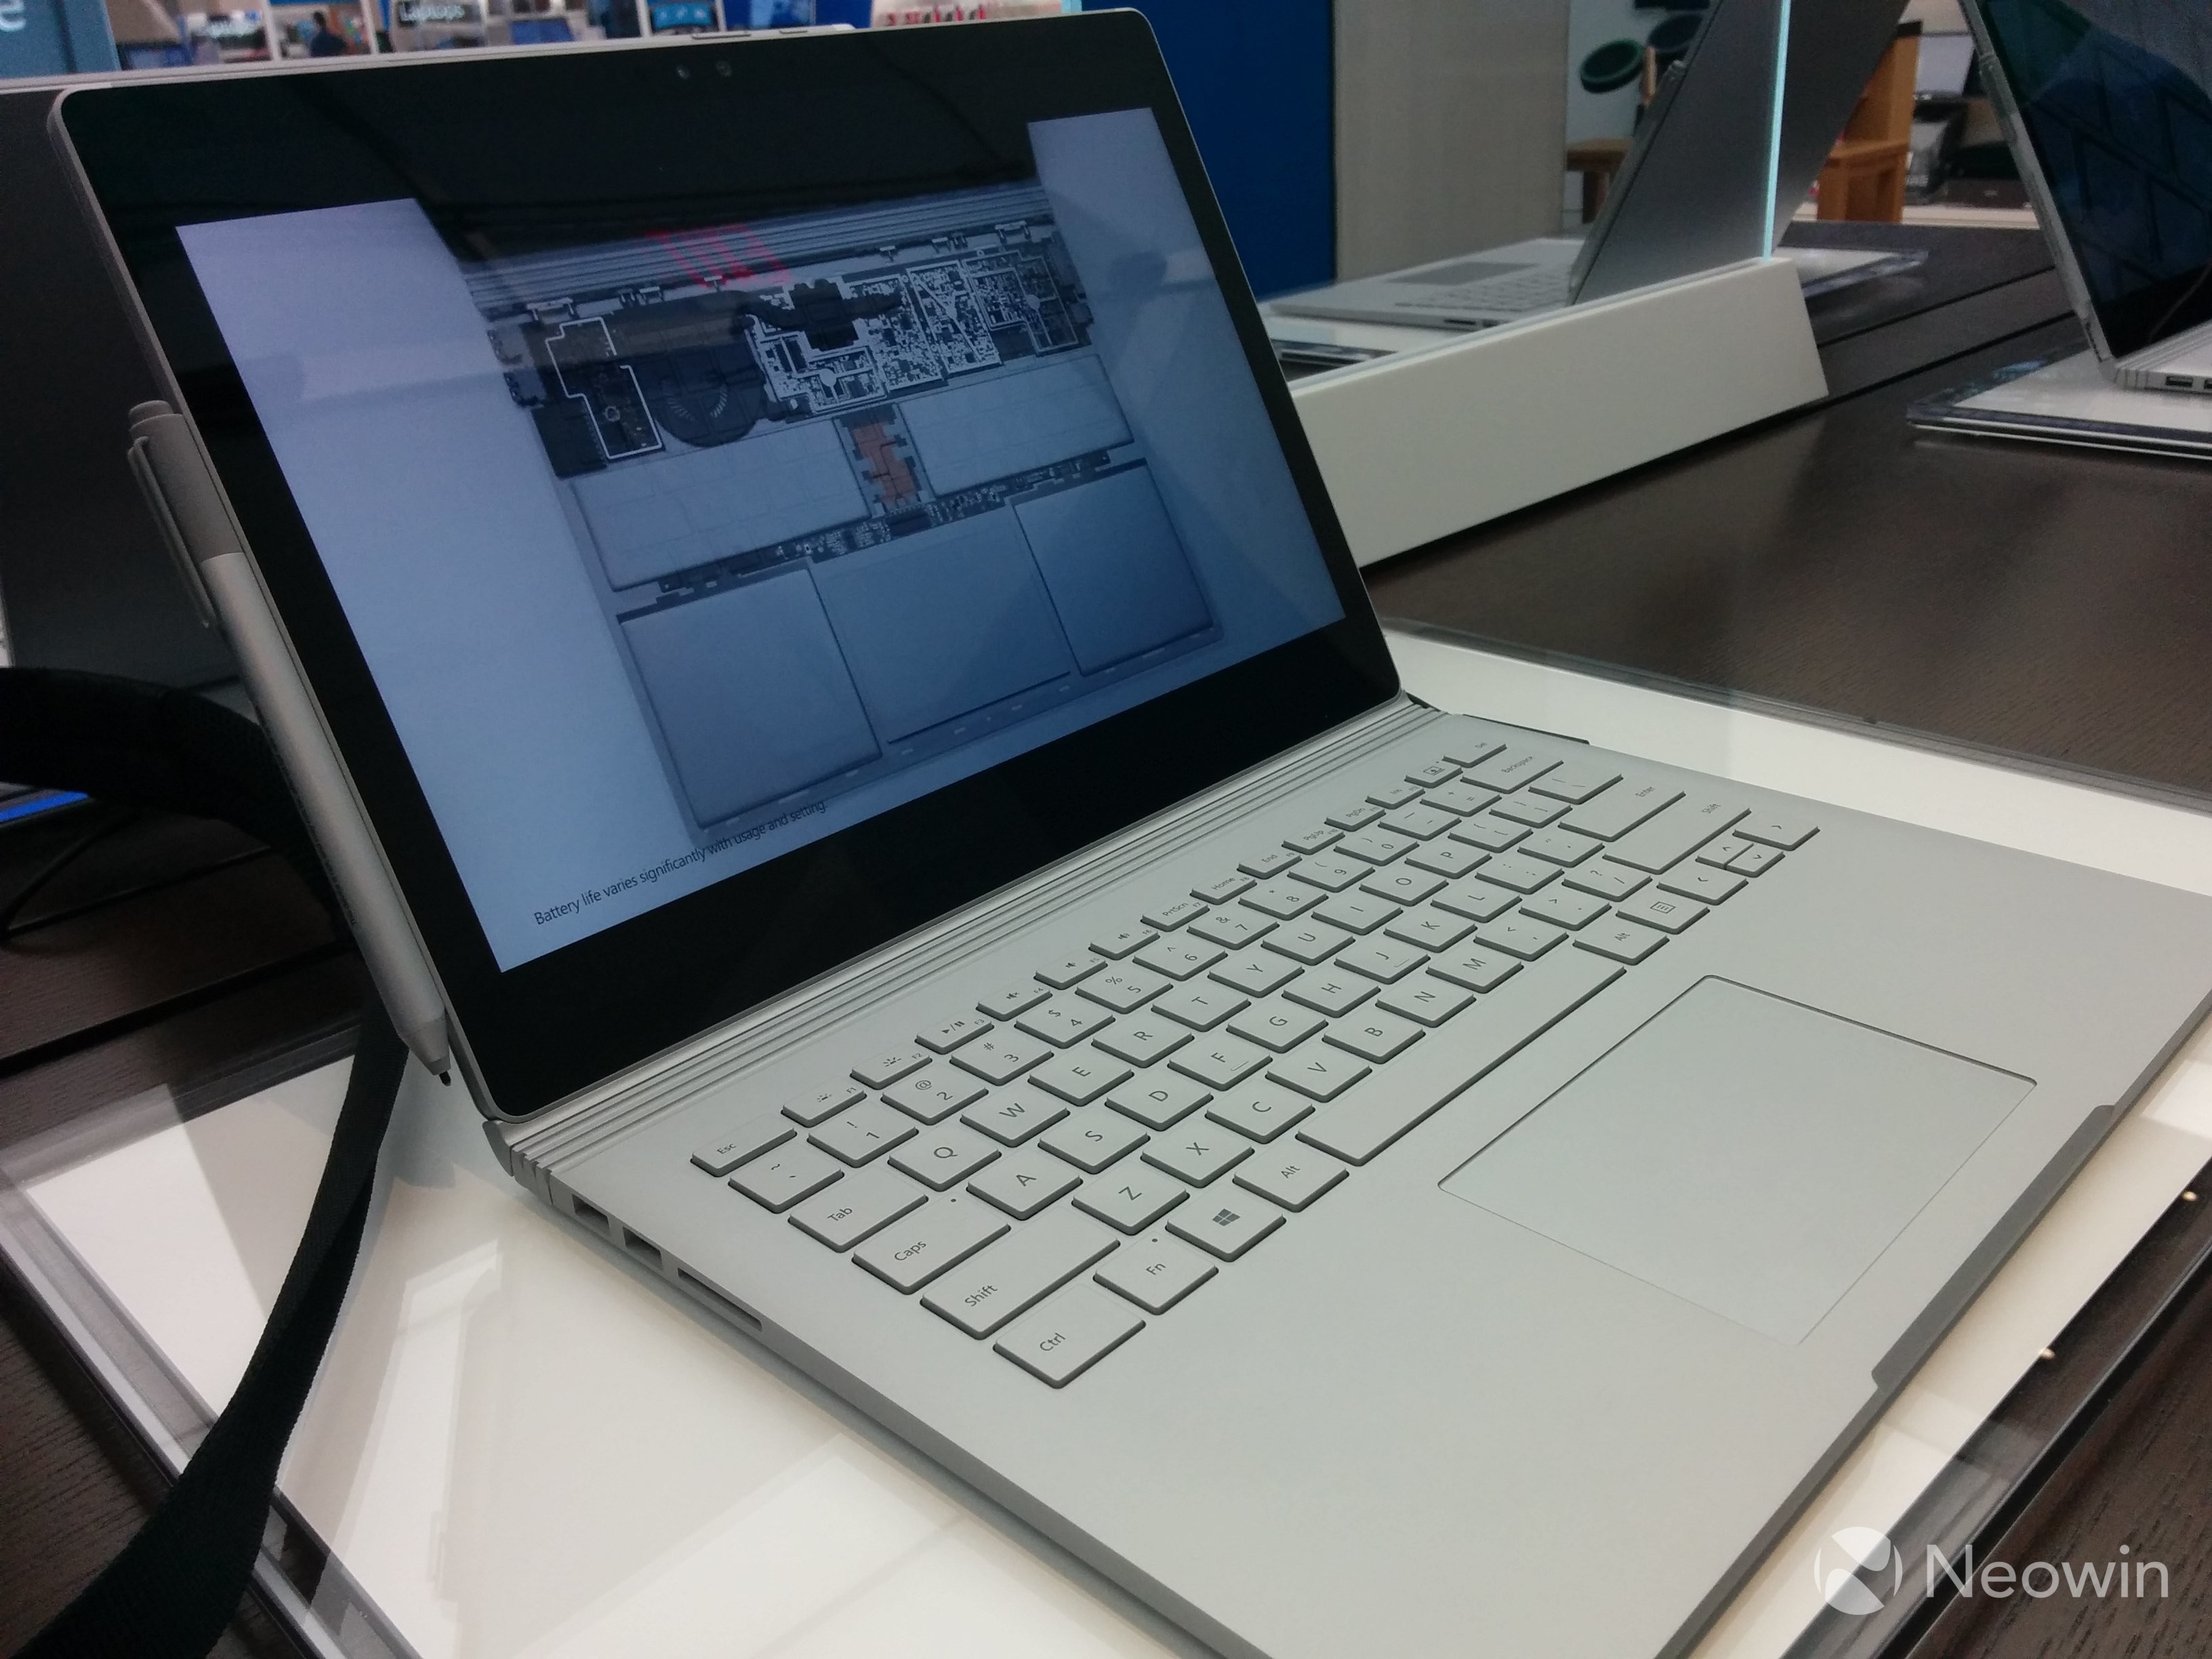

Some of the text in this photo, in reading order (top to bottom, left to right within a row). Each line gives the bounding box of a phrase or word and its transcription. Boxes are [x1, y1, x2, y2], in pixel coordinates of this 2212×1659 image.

[1635, 787, 1654, 796] Enter
[1702, 804, 1720, 813] Shift
[1303, 831, 1324, 840] PgUp
[1261, 854, 1278, 863] End
[534, 899, 580, 925] Battery
[581, 890, 602, 905] life
[603, 876, 638, 897] varies
[639, 848, 706, 884] significantly
[708, 838, 733, 855] with
[734, 825, 766, 840] usage
[769, 813, 789, 830] and
[1212, 878, 1235, 889] Home
[1395, 878, 1412, 886] O
[1163, 903, 1188, 916] PrtScn
[1420, 921, 1440, 930] K
[1297, 933, 1316, 942] U
[1614, 933, 1631, 941] Alt
[1375, 951, 1389, 960] J
[1246, 964, 1263, 972] Y
[1462, 958, 1486, 970] M
[1105, 976, 1123, 985] %
[1127, 985, 1141, 994] 5
[1322, 983, 1341, 994] H
[1191, 996, 1208, 1005] T
[1414, 991, 1435, 1002] N
[1048, 1009, 1061, 1017] $
[1070, 1019, 1083, 1027] 4
[1269, 1017, 1288, 1025] G
[1133, 1031, 1153, 1040] R
[1364, 1027, 1383, 1037] B
[983, 1042, 994, 1051] #
[1004, 1054, 1019, 1063] 3
[1211, 1052, 1225, 1063] F
[1072, 1067, 1090, 1076] E
[1307, 1063, 1326, 1071] V
[916, 1080, 931, 1090] @
[936, 1092, 954, 1101] 2
[1149, 1091, 1168, 1101] D
[999, 1103, 1025, 1117] W
[1252, 1102, 1271, 1112] C
[1085, 1131, 1103, 1141] S
[717, 1144, 736, 1154] Esc
[934, 1147, 958, 1158] Q
[1186, 1142, 1209, 1155] X
[1282, 1166, 1300, 1178] Alt
[1016, 1175, 1036, 1187] A
[1119, 1187, 1142, 1200] Z
[827, 1208, 852, 1221] Tab
[895, 1242, 926, 1261] Caps
[1146, 1264, 1166, 1275] Fn
[965, 1286, 997, 1306] Shift
[1040, 1333, 1065, 1351] Ctrl
